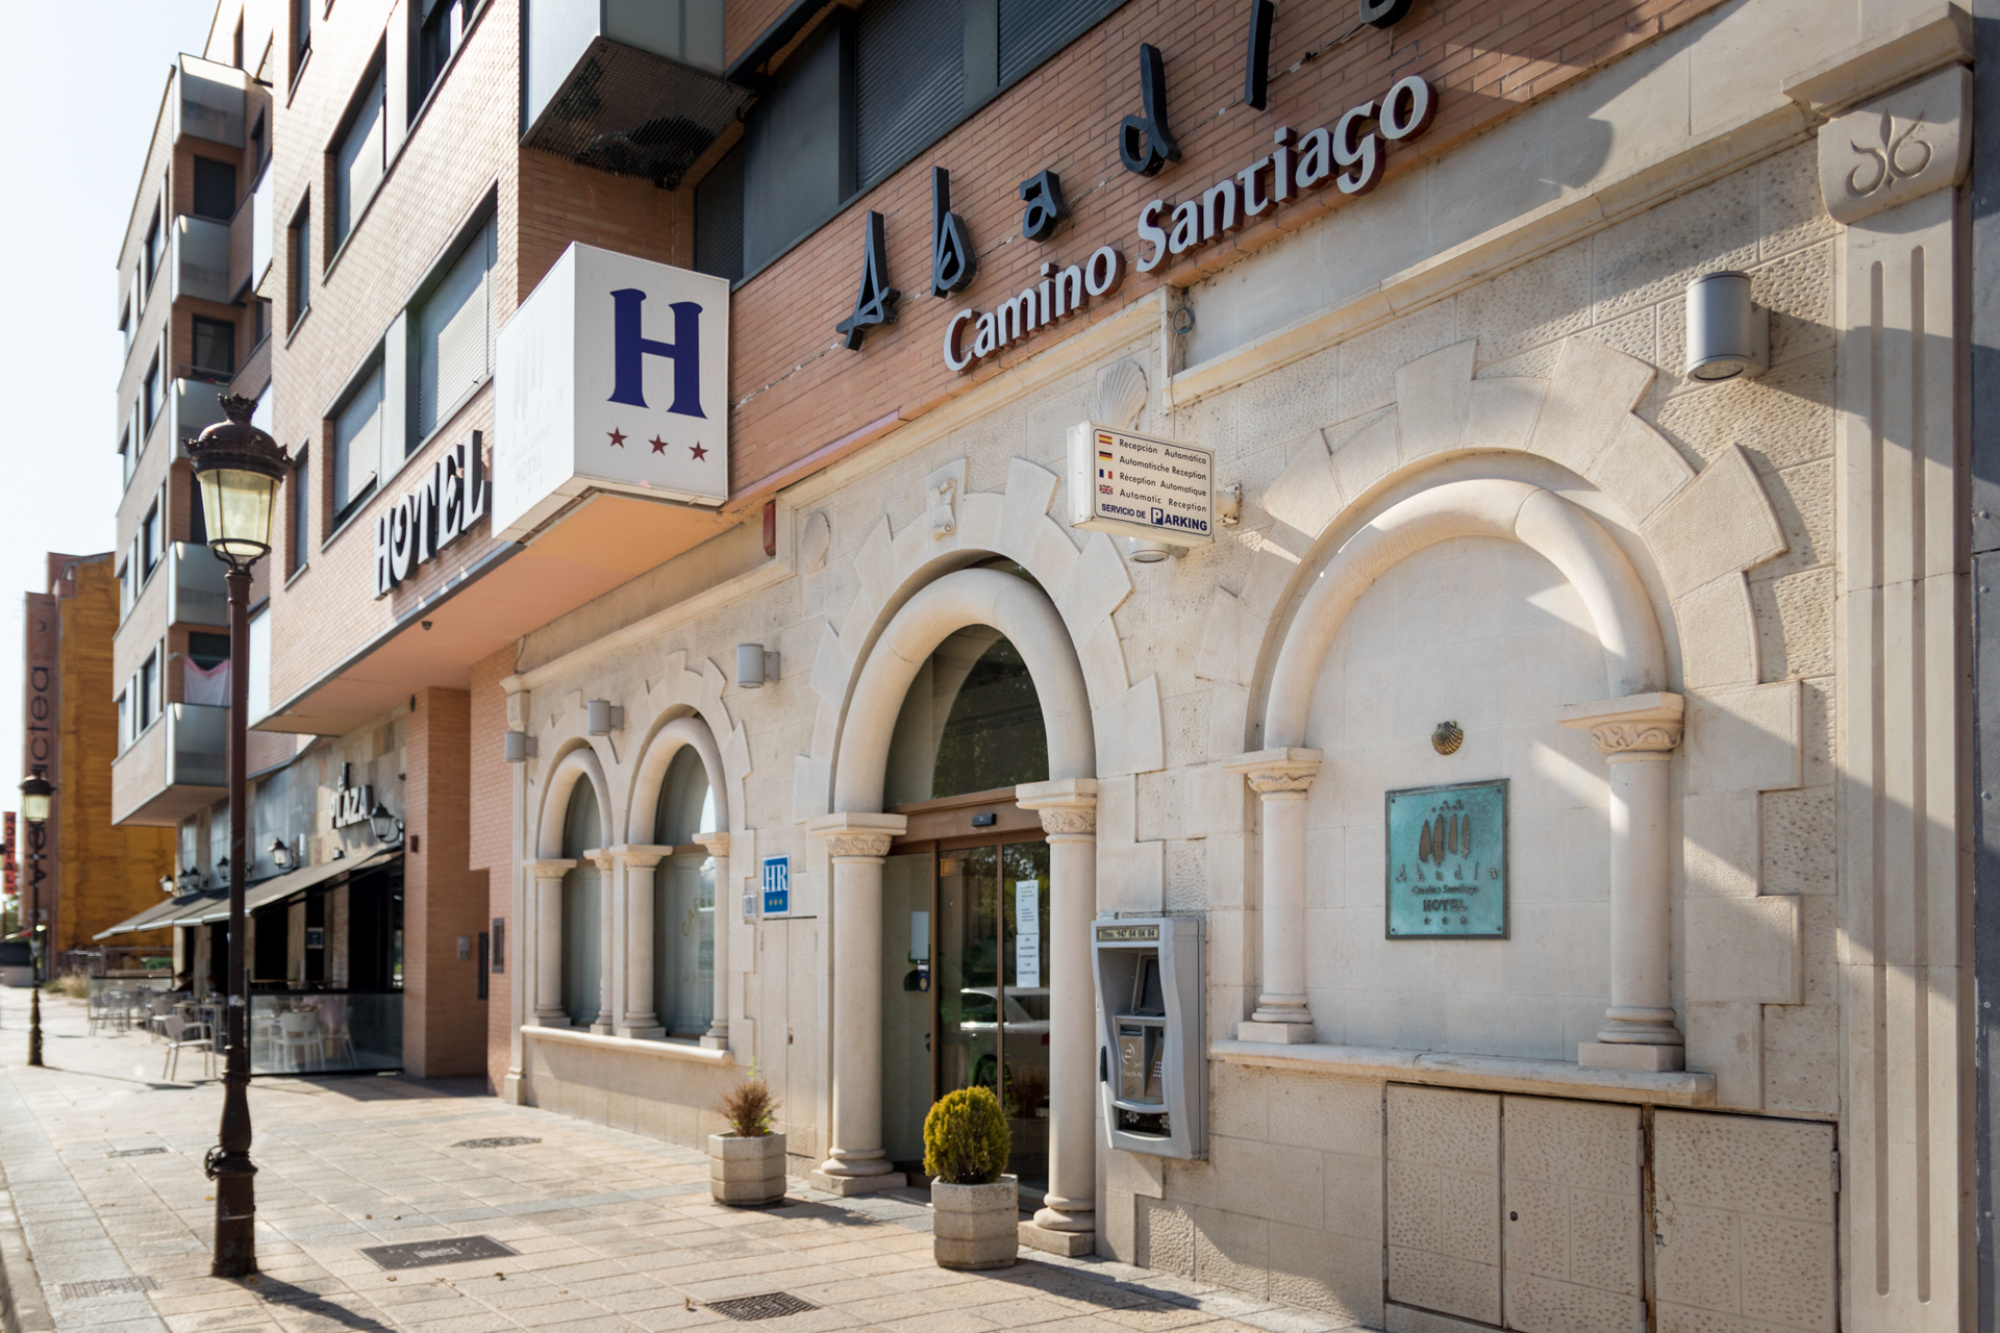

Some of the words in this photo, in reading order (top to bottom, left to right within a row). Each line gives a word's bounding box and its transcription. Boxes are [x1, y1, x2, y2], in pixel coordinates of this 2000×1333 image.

[943, 245, 1126, 374] Camino
[1136, 75, 1438, 274] Santiago
[606, 287, 708, 419] H
[1119, 439, 1158, 454] Recepción
[1164, 448, 1207, 465] Automática
[1119, 455, 1170, 473] Automatische
[1172, 465, 1207, 480] Rezeption
[1119, 472, 1156, 487] Réception
[1160, 480, 1207, 497] Automatique
[1119, 489, 1162, 504] Automatic
[1168, 498, 1207, 513] Reception
[373, 429, 484, 601] HOTEL
[1101, 503, 1135, 517] SERVICIO
[1136, 509, 1146, 519] DE
[1151, 507, 1207, 531] PARKING
[329, 785, 373, 831] PLAZA
[764, 864, 788, 892] HR
[1423, 898, 1468, 912] HOTEL
[1117, 929, 1127, 938] 947
[1129, 929, 1136, 938] 04
[1138, 929, 1146, 938] 04
[1147, 929, 1155, 938] 04
